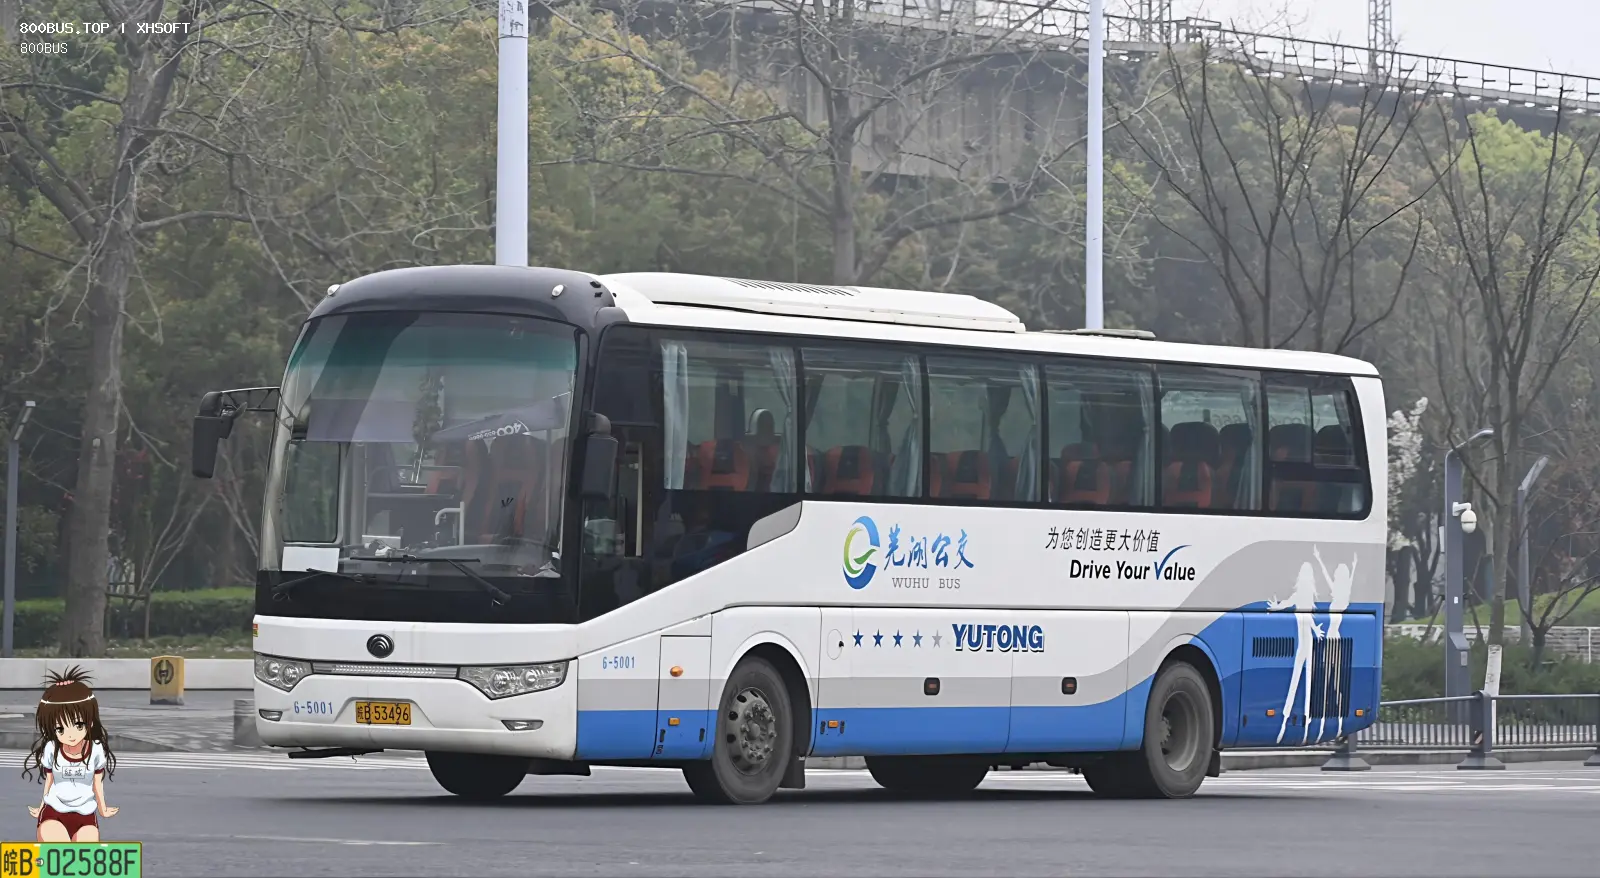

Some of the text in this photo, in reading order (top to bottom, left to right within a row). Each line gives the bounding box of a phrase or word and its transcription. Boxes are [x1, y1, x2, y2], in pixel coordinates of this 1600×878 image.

[1045, 526, 1161, 553] 为您创造更大价值
[1069, 544, 1196, 581] Drive Your Value
[892, 576, 961, 590] WUHU BUS
[951, 623, 1045, 653] YUTONG
[602, 655, 635, 670] 6-5001
[293, 700, 334, 715] 6-5001
